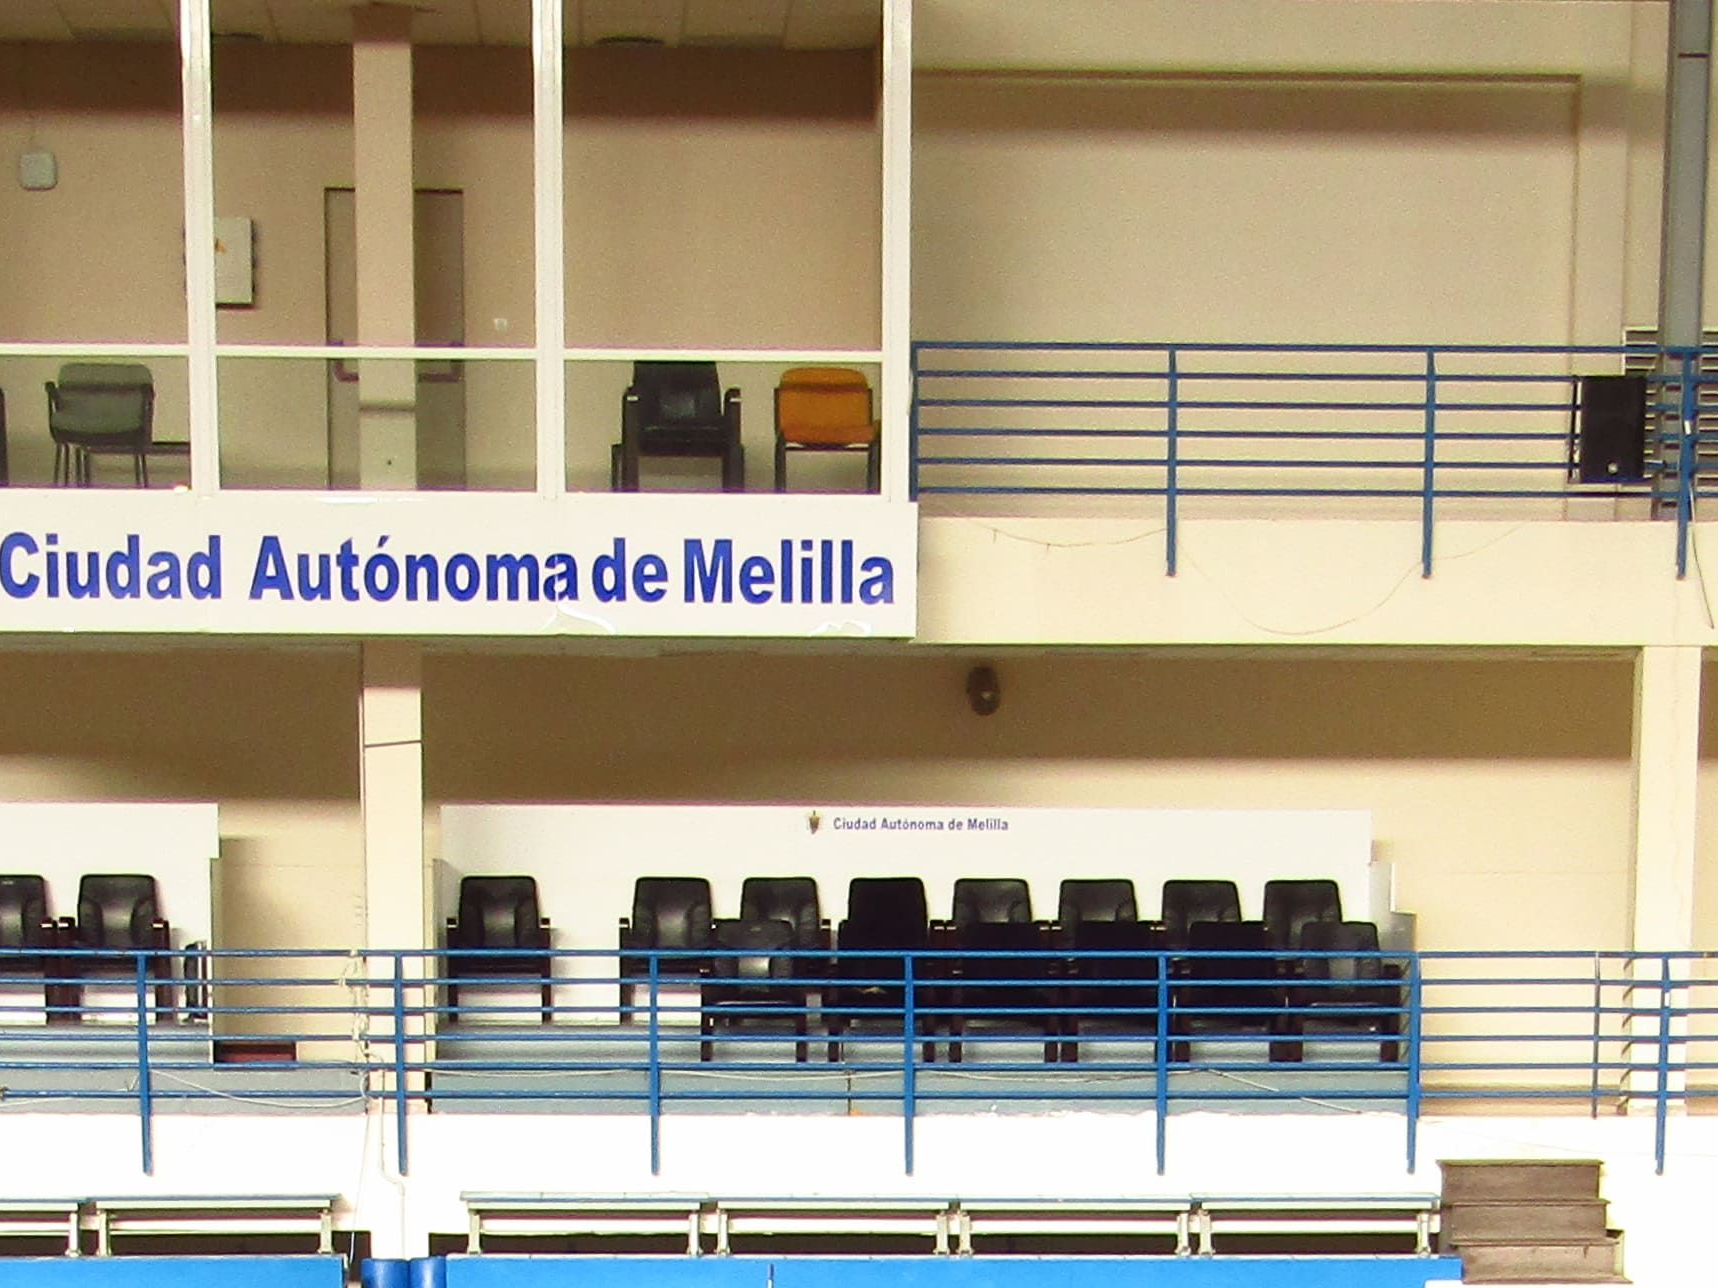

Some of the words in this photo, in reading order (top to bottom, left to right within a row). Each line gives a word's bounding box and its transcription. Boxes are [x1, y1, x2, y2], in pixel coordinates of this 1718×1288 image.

[249, 533, 579, 603] Autónoma
[591, 537, 668, 603] de
[685, 538, 895, 605] Melilla
[833, 817, 877, 830] Ciudad
[881, 817, 944, 831] Autónoma
[948, 818, 963, 831] de
[967, 818, 1009, 831] Melilla
